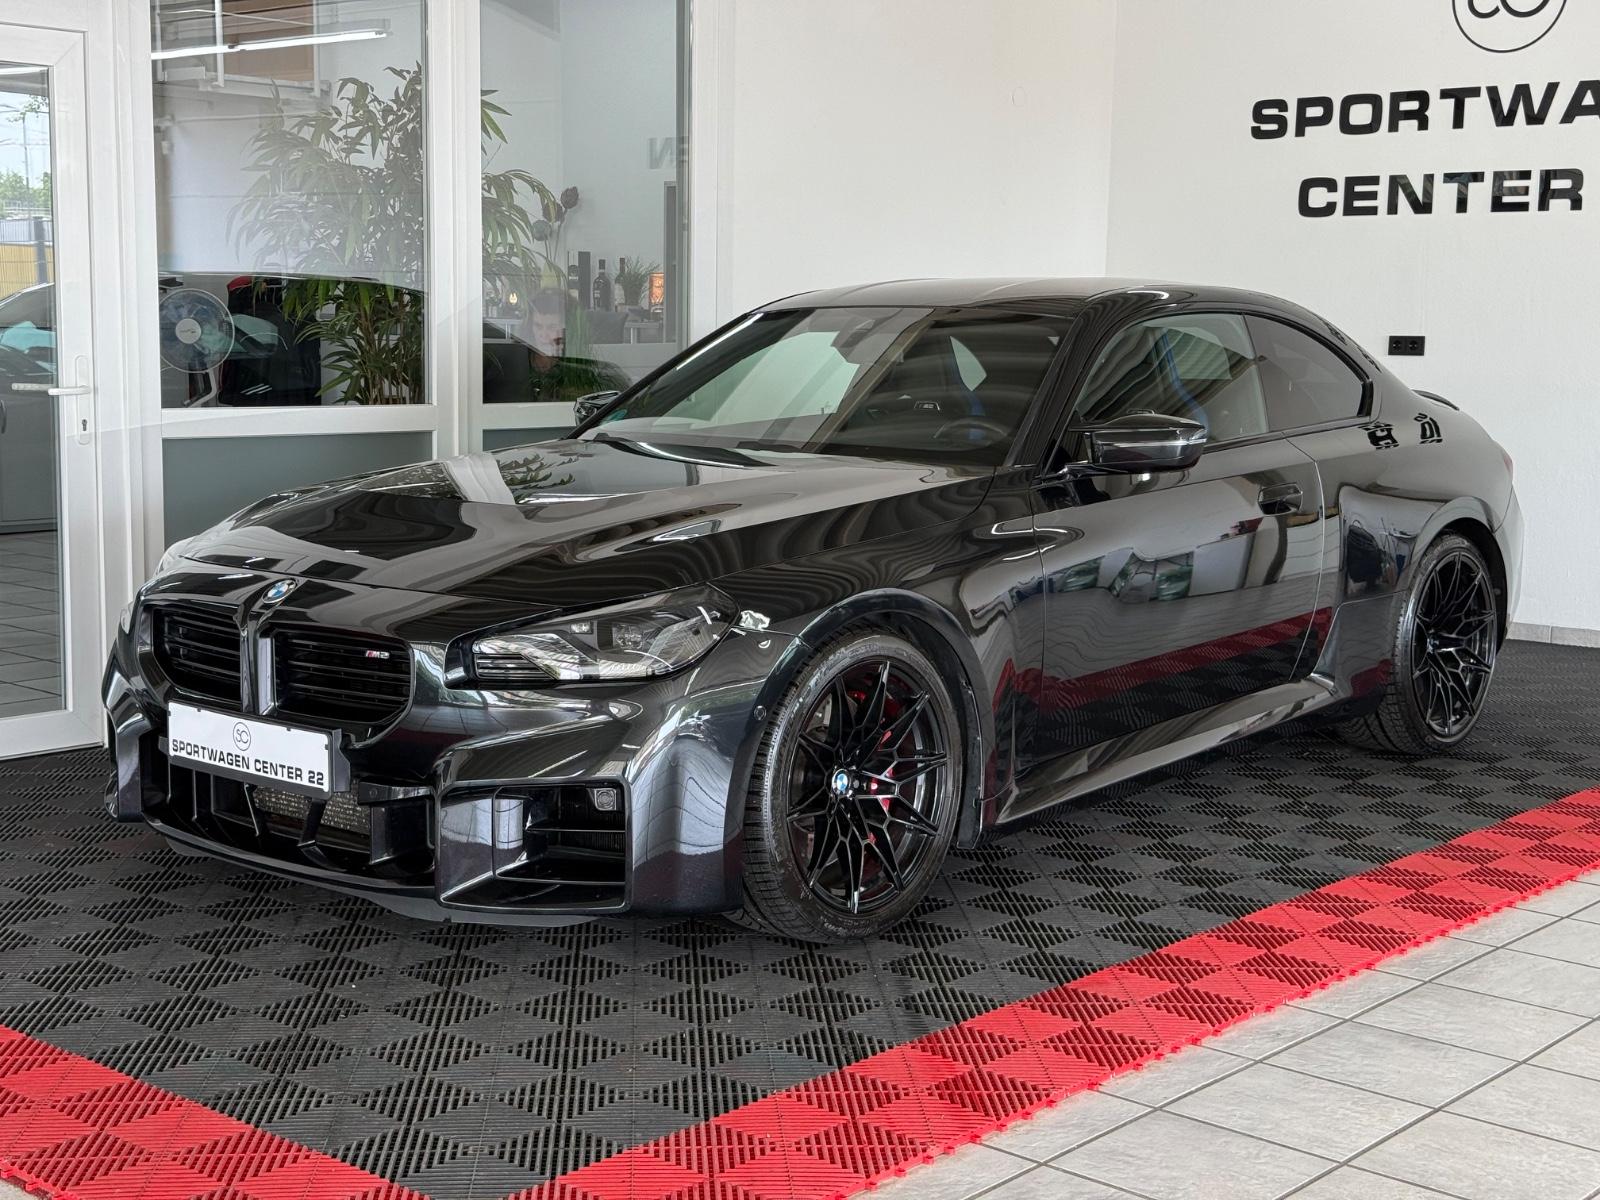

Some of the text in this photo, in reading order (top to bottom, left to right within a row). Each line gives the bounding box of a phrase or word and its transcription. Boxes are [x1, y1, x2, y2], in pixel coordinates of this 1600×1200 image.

[1298, 168, 1584, 217] CENTER
[235, 728, 249, 744] SC
[172, 739, 324, 785] SPORTWAGEN CENTER 22
